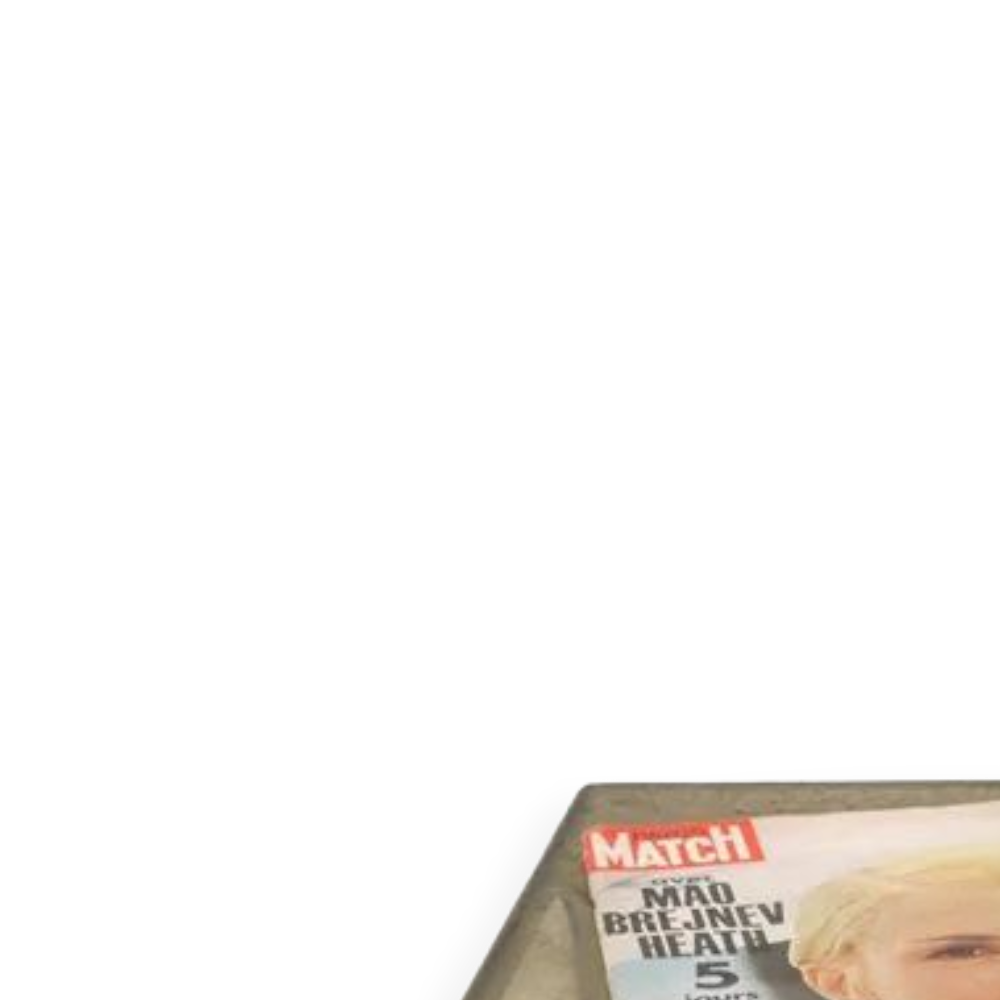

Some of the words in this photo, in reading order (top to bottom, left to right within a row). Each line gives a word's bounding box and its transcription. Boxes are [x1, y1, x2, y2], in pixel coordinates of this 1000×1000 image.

[590, 824, 749, 868] MATCH
[641, 882, 736, 908] MAO
[602, 902, 785, 935] BREJNEV
[637, 930, 768, 959] HEATH
[694, 962, 740, 989] 5
